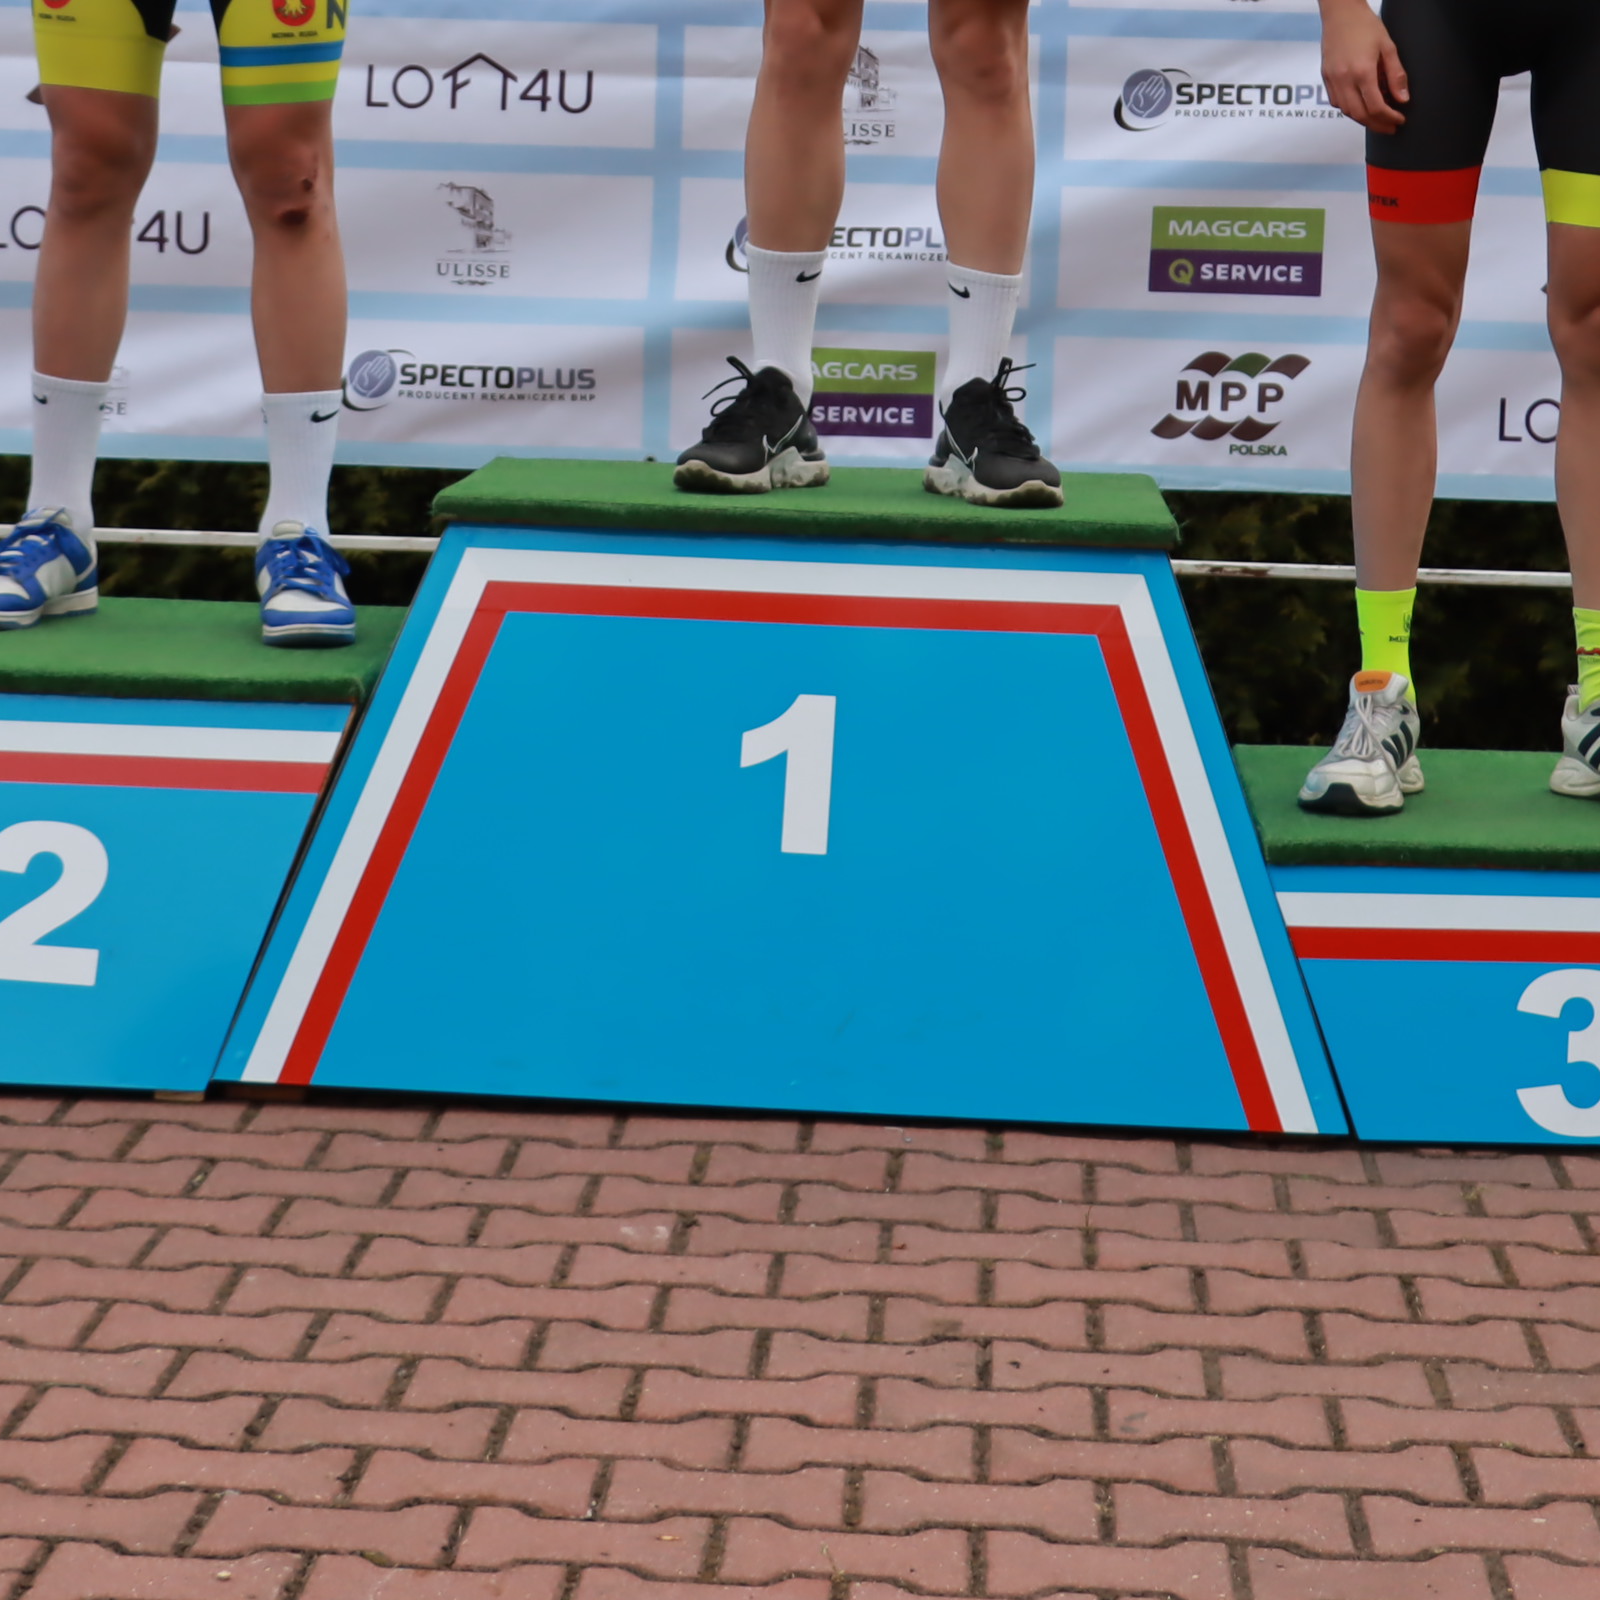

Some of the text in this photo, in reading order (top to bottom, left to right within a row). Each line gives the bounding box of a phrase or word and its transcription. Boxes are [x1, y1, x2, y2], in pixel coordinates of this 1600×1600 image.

[366, 52, 594, 114] LOFT4U
[1175, 82, 1336, 106] SPECTOPL
[1175, 108, 1254, 118] PRODUCENT
[1168, 220, 1307, 238] MAGCARS
[436, 260, 510, 279] ULISSE
[1200, 263, 1303, 283] SERVICE
[400, 363, 596, 390] SPECTOPLUS
[399, 390, 475, 401] PRODUCENT
[571, 393, 596, 402] BHP
[1176, 380, 1284, 413] MPP
[812, 406, 914, 424] SERVICE
[1229, 444, 1287, 456] POLSKA
[740, 694, 836, 856] 1
